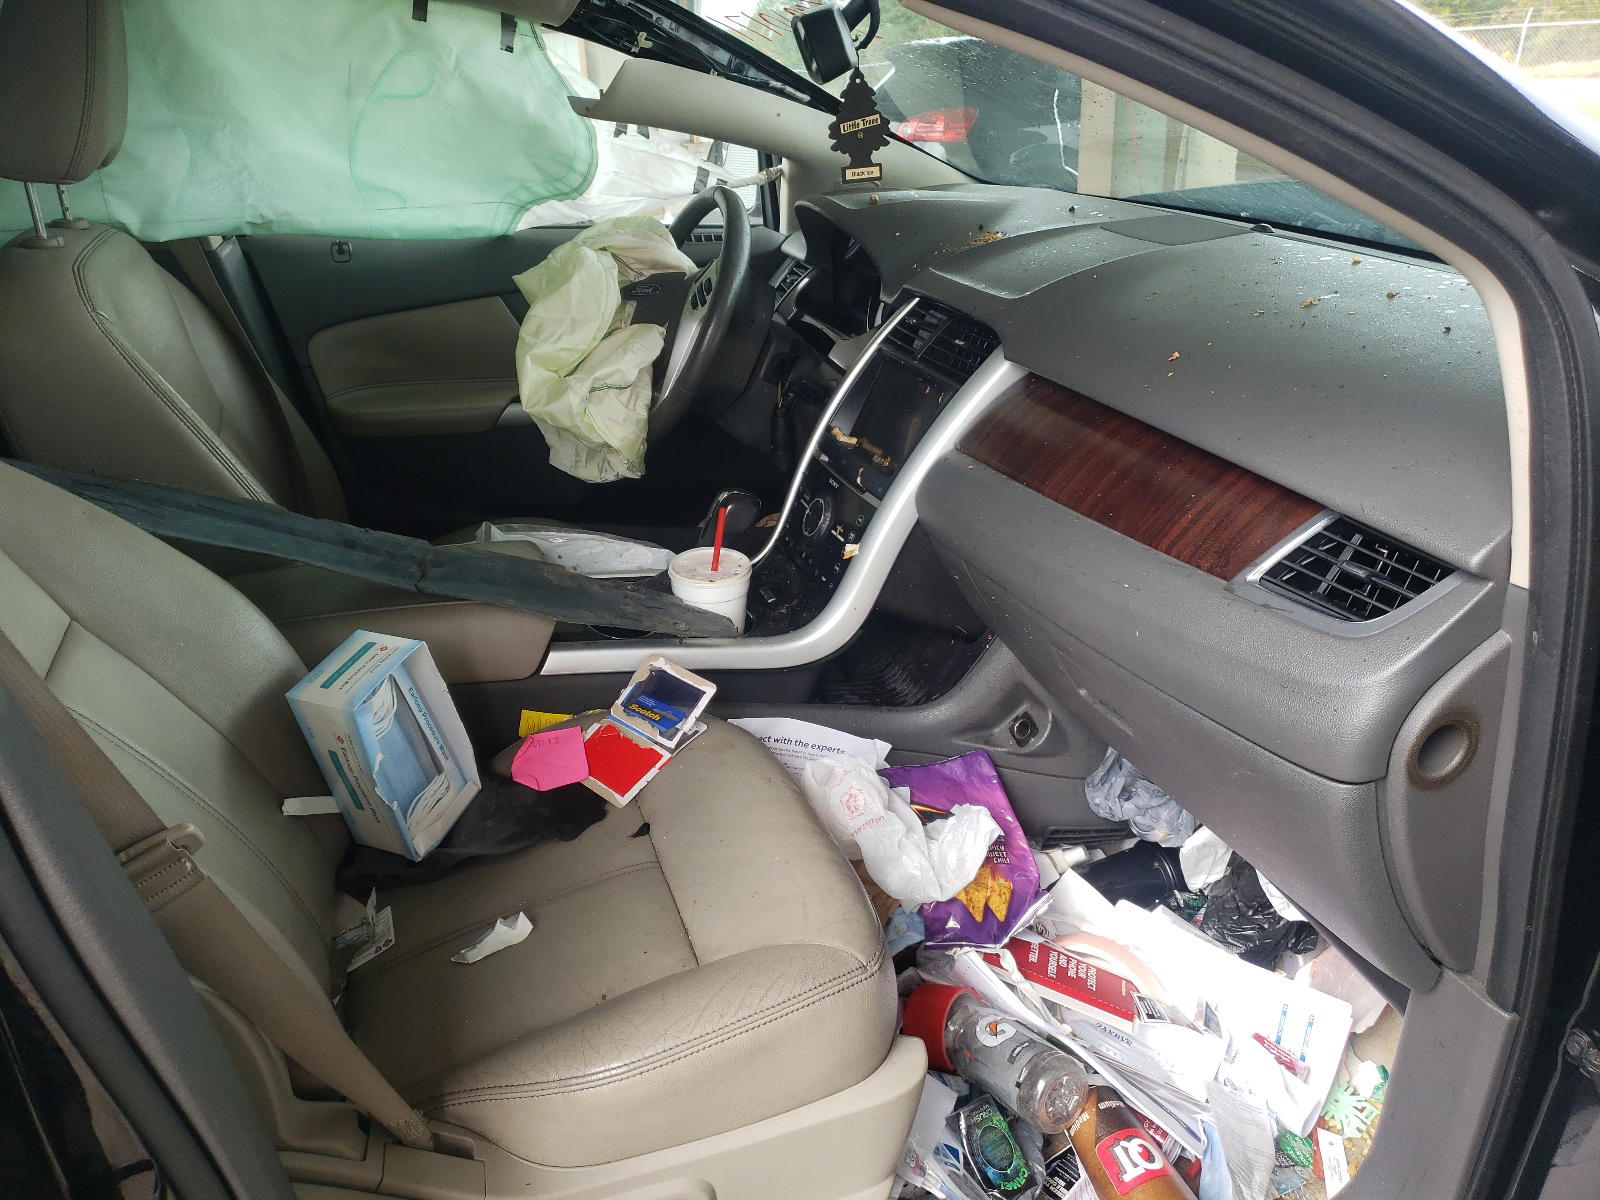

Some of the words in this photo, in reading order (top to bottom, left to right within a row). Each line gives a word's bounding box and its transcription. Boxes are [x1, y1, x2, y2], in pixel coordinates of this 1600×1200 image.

[842, 120, 860, 132] Little
[860, 117, 879, 127] Trees
[407, 686, 424, 714] Earloop
[420, 711, 441, 744] Procedure
[630, 702, 662, 722] Scotch
[773, 736, 793, 746] with
[794, 739, 810, 749] the
[1059, 953, 1067, 968] AND
[1067, 957, 1077, 979] PHONE
[1078, 962, 1087, 979] YOUR
[1087, 965, 1097, 992] PROTECT
[1113, 1137, 1164, 1183] QT
[997, 1167, 1028, 1190] CAMEL
